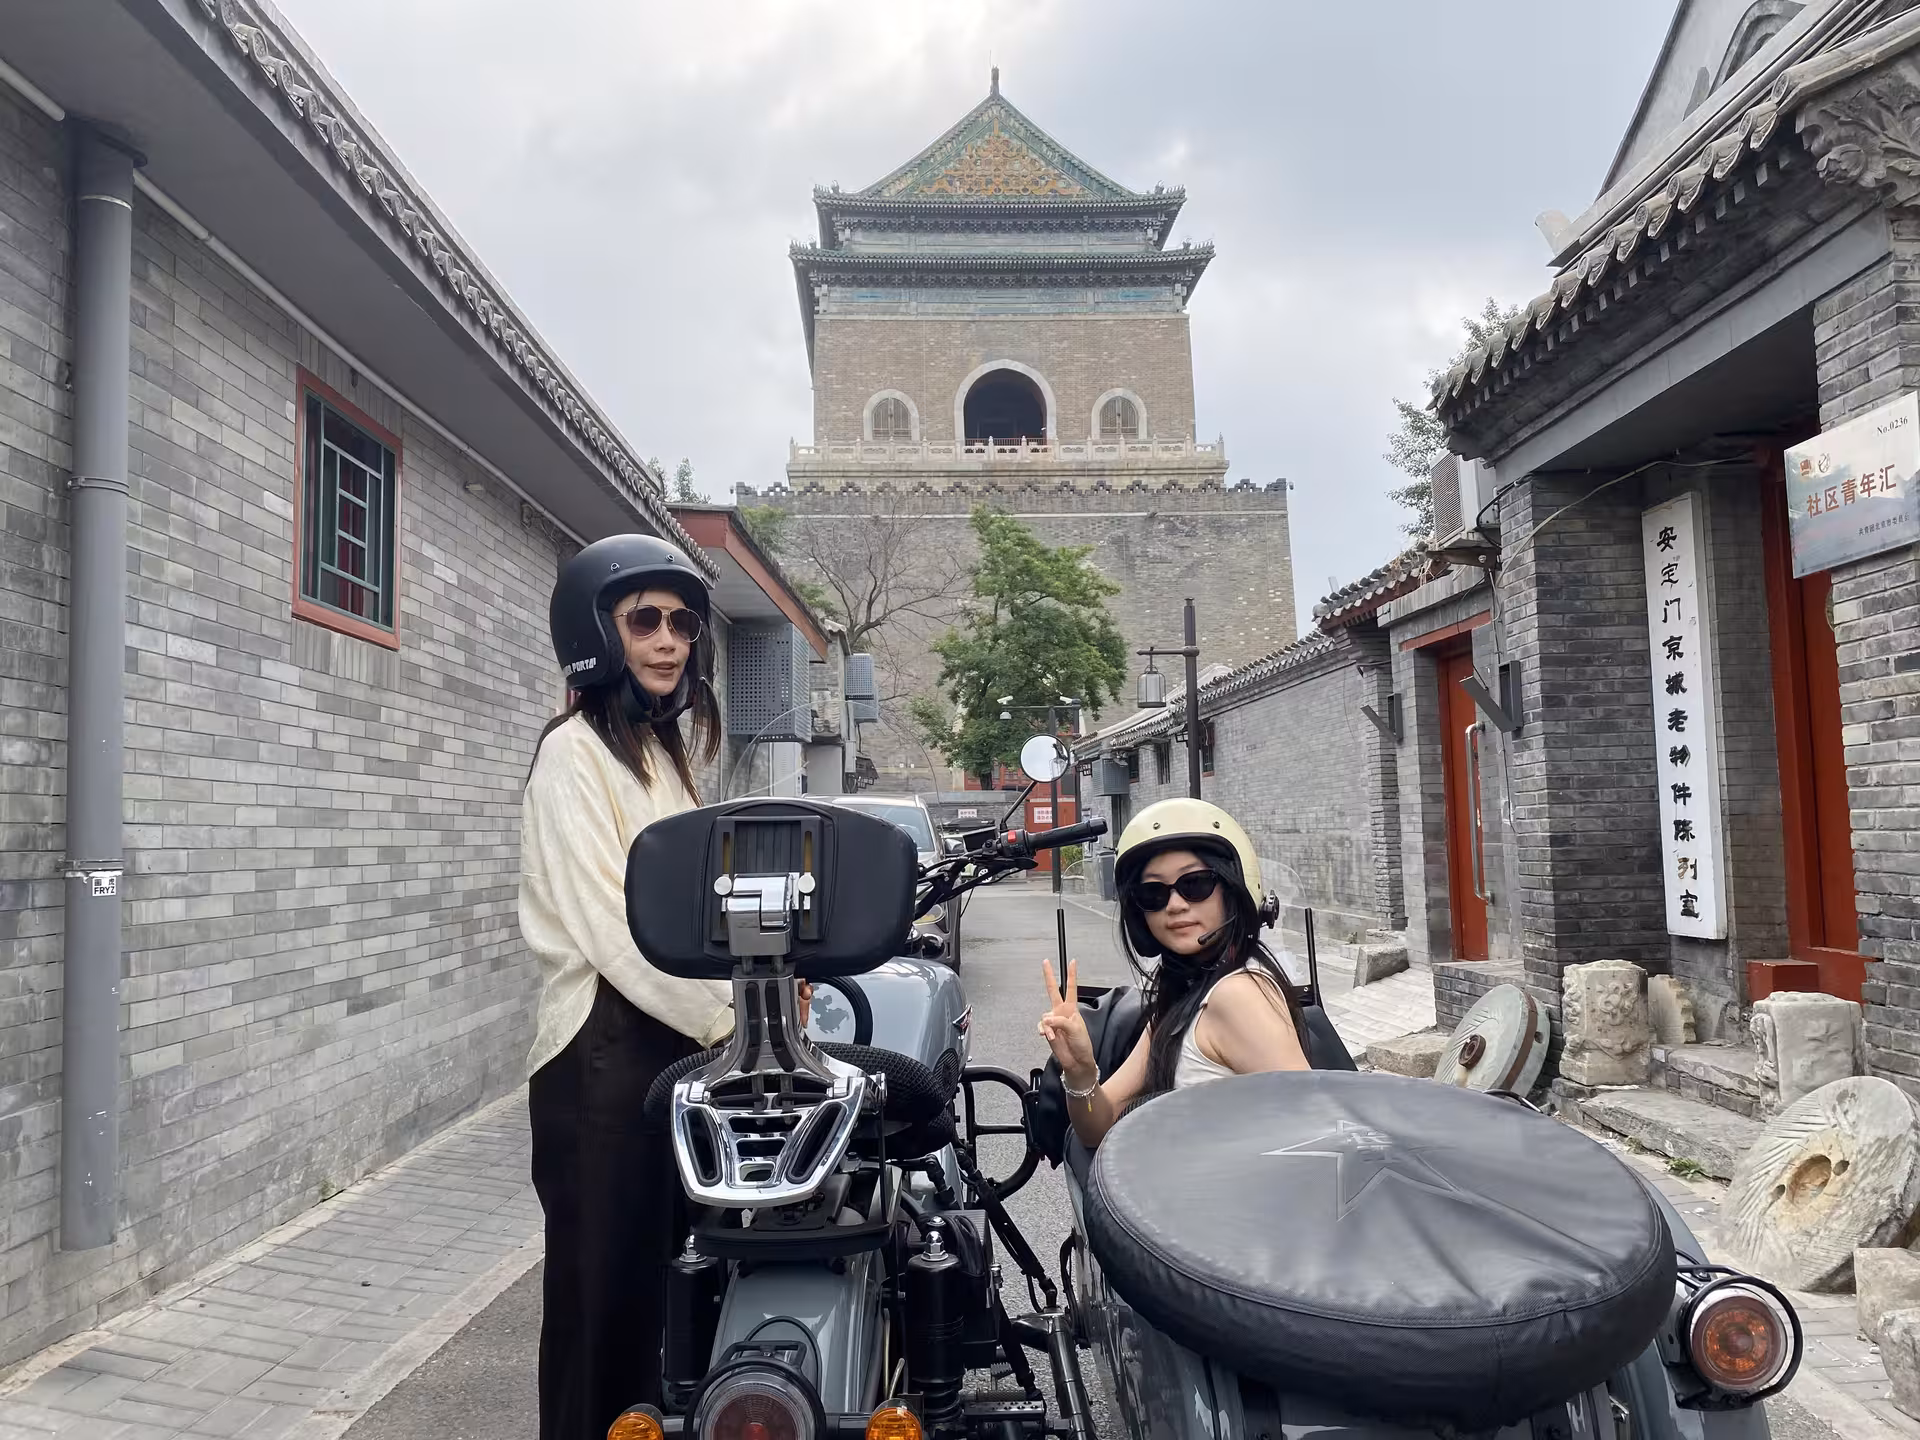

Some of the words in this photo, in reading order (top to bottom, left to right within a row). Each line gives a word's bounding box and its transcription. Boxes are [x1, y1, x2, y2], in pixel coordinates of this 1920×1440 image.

[1877, 416, 1908, 435] No.0236
[1807, 464, 1897, 518] 社区青年汇
[1656, 526, 1700, 919] 安定门京城老物件陈列室
[94, 886, 115, 894] FRYZ
